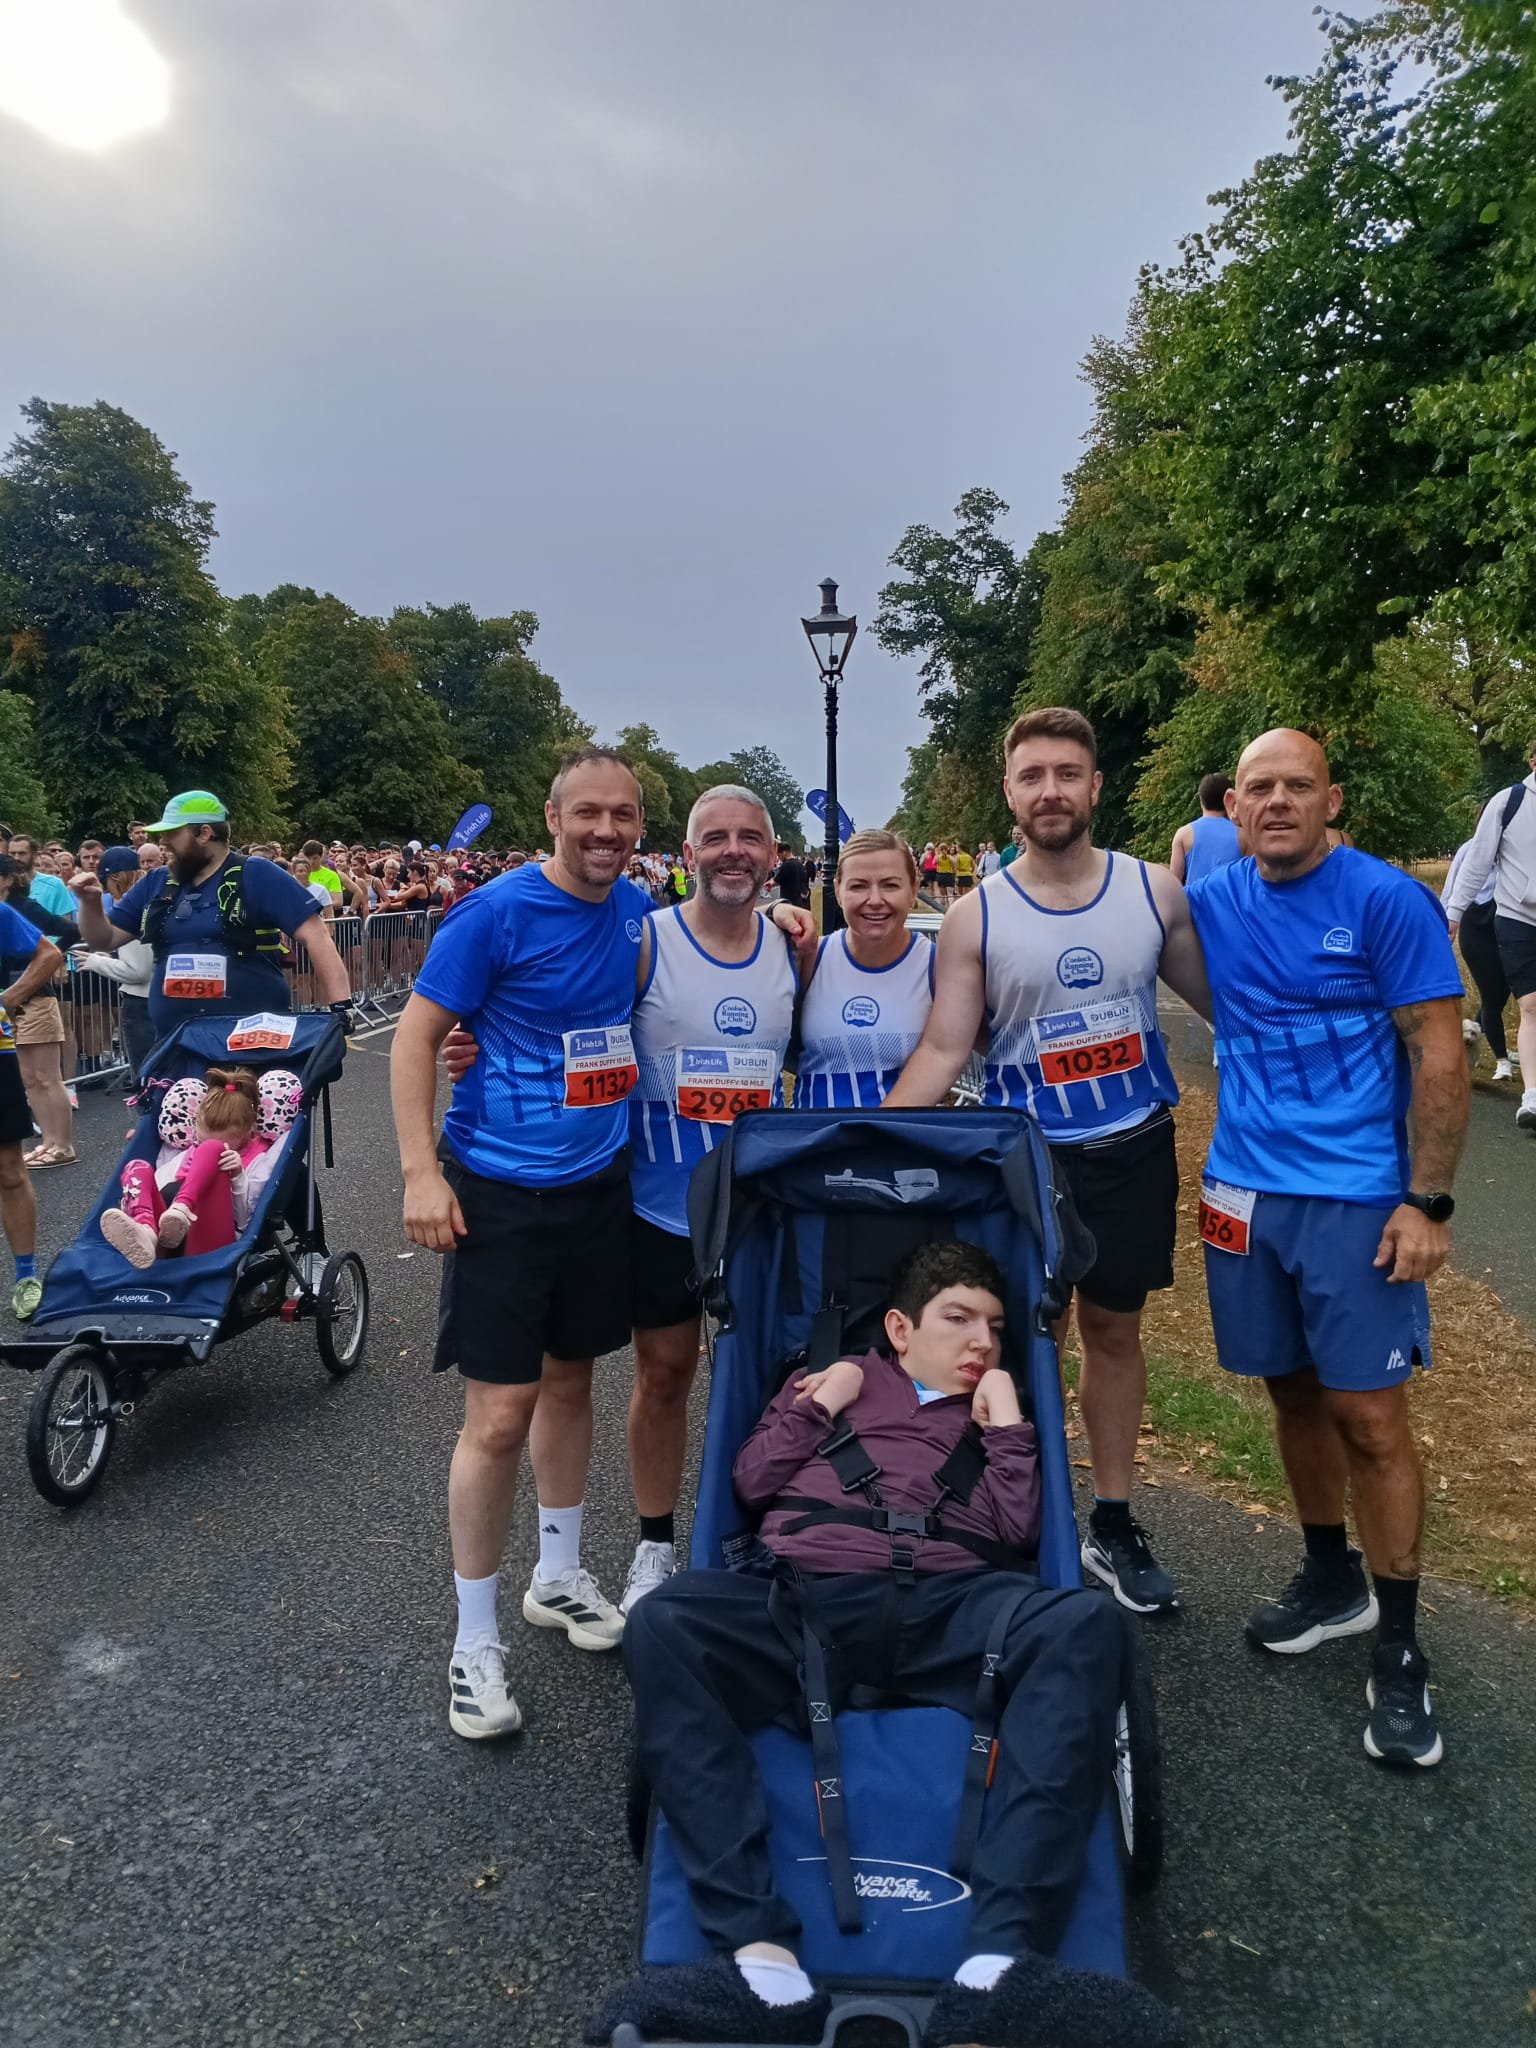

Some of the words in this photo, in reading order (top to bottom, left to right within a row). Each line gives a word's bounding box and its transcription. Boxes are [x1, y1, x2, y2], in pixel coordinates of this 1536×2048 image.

[464, 822, 479, 837] Irish
[476, 812, 489, 824] Life
[172, 981, 215, 995] 4781
[722, 1010, 749, 1018] Running
[1090, 1006, 1129, 1022] DUBLIN
[1052, 1022, 1067, 1031] Irish
[1068, 1020, 1080, 1028] Life
[235, 1031, 282, 1046] 3858
[581, 1040, 594, 1049] Irish
[610, 1034, 630, 1044] DUBLIN
[1048, 1040, 1075, 1050] FRANK
[1076, 1035, 1101, 1046] DUFFY
[1114, 1026, 1130, 1037] MILE
[575, 1060, 598, 1069] FRANK
[600, 1058, 616, 1067] DUFFY
[711, 1057, 723, 1066] Life
[733, 1056, 768, 1067] DUBLIN
[1056, 1041, 1131, 1077] 1032
[583, 1070, 629, 1100] 1132
[688, 1077, 715, 1085] FRANK
[715, 1078, 738, 1086] DUFFY
[690, 1090, 761, 1115] 2965
[1222, 1202, 1228, 1210] 10
[1228, 1206, 1241, 1217] MILE
[113, 1295, 149, 1303] Advance
[853, 1872, 919, 1887] dvance
[855, 1884, 931, 1902] Mobility
